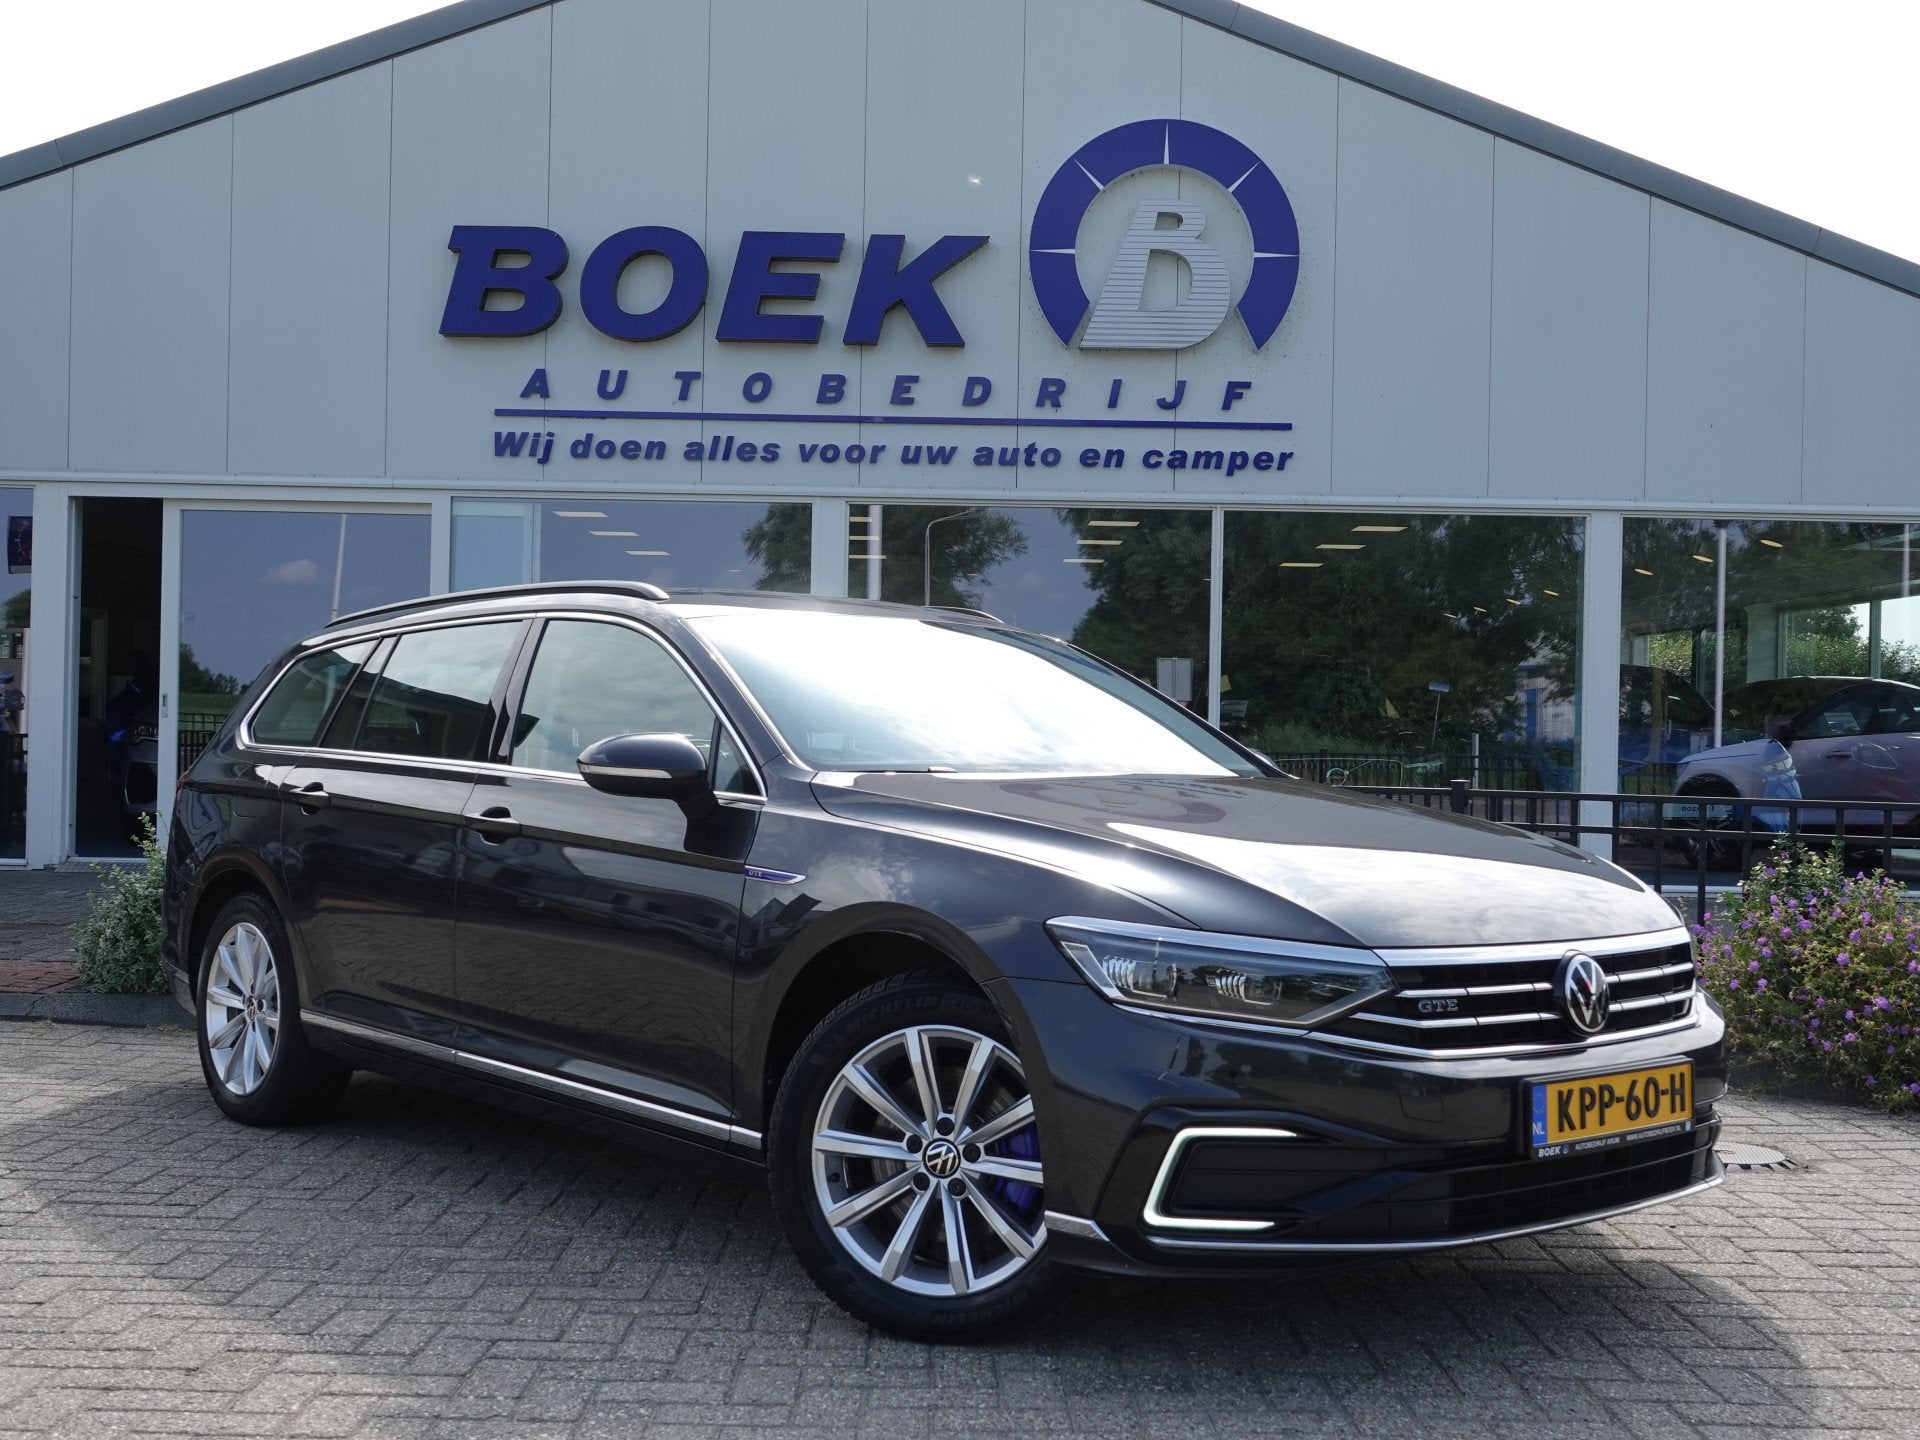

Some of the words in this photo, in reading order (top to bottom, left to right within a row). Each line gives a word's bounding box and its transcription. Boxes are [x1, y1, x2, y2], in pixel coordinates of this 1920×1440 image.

[438, 224, 991, 349] BOEK
[519, 368, 1253, 411] AUTOBEDRIJF
[494, 431, 555, 464] Wij
[570, 433, 667, 460] doen
[684, 435, 781, 462] alles
[799, 443, 886, 465] voor
[901, 444, 958, 466] uw
[973, 442, 1062, 468] auto
[1079, 448, 1125, 469] en
[1142, 447, 1295, 476] camper
[1418, 998, 1459, 1014] GTE
[1557, 1071, 1686, 1133] KPP-60-H
[1532, 1121, 1546, 1136] NL
[1538, 1145, 1562, 1158] BOEK
